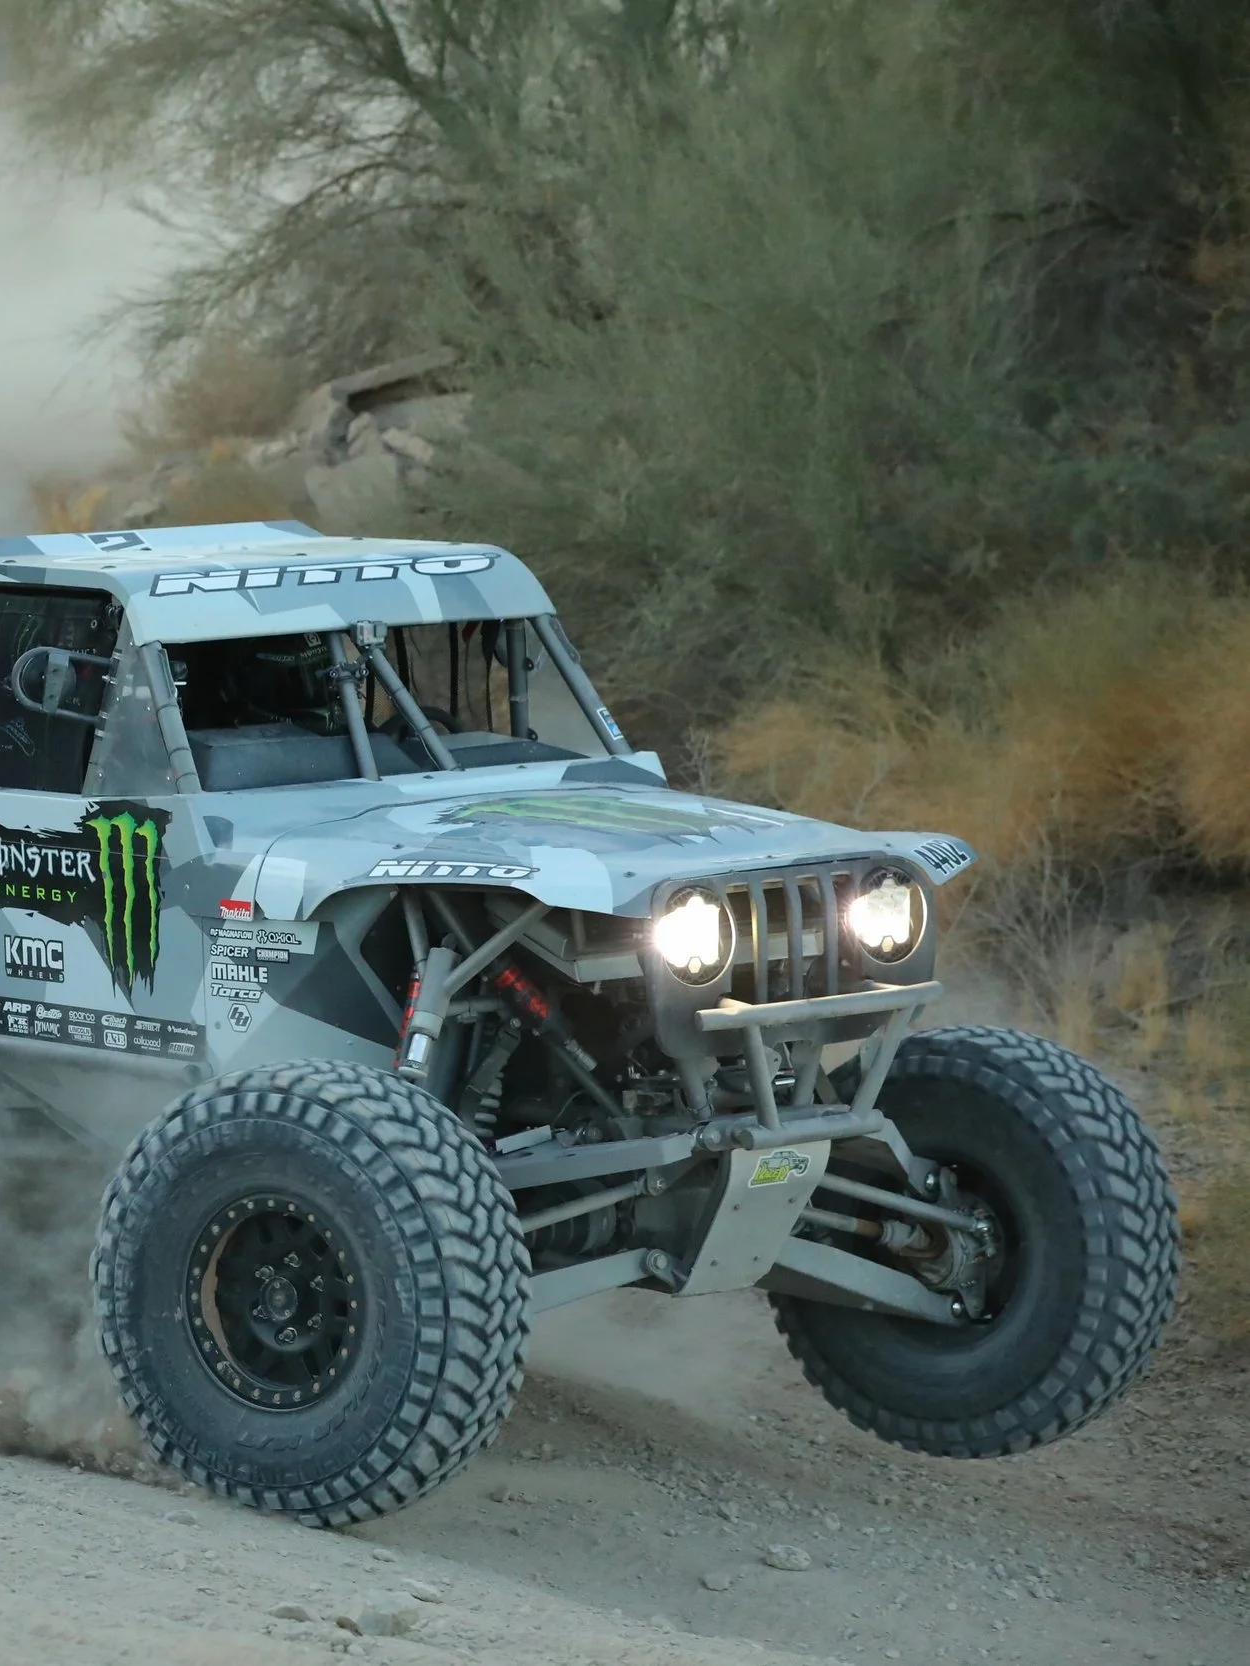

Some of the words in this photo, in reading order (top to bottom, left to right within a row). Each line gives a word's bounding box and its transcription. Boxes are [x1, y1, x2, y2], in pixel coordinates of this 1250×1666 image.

[150, 553, 496, 597] NITTO
[368, 859, 533, 879] NITTO
[5, 936, 64, 970] KMC
[210, 945, 249, 958] SPICER
[6, 968, 64, 982] WHEELS
[211, 963, 268, 983] MAHLE
[210, 984, 262, 999] Torco
[3, 1001, 31, 1014] ARP
[68, 1010, 95, 1022] sparco
[34, 1020, 61, 1037] DYNAMIC
[106, 1032, 125, 1046] ARB
